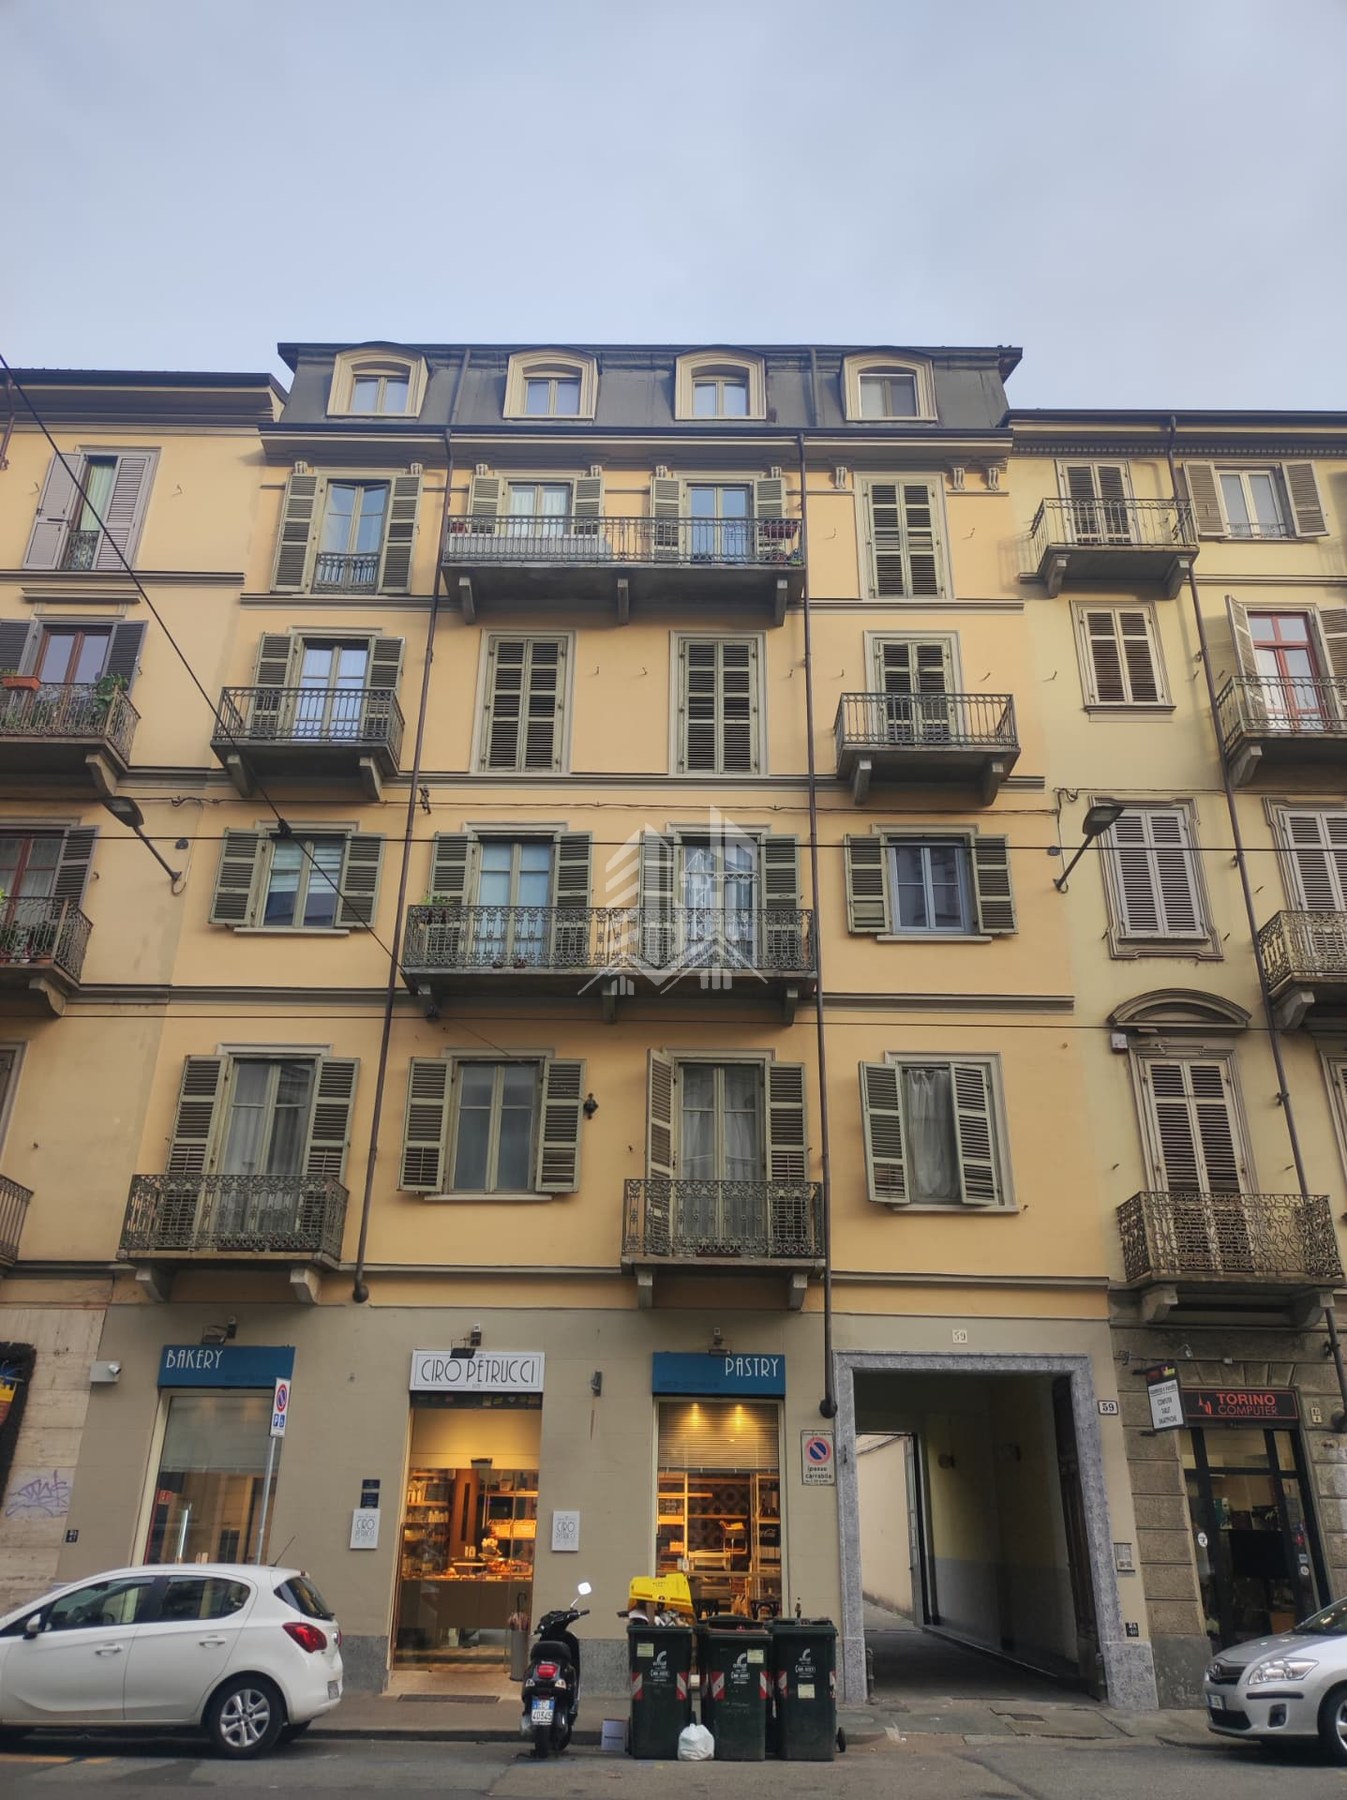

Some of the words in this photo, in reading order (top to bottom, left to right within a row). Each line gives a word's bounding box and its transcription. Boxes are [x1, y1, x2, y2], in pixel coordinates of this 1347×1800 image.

[165, 1349, 224, 1369] BAKERY
[421, 1359, 462, 1382] CIRO
[466, 1360, 535, 1383] PETRUCCI
[724, 1357, 779, 1377] PASTRY
[1216, 1393, 1276, 1406] TORINO
[1101, 1402, 1115, 1412] 59
[1217, 1404, 1279, 1416] COMPUTER
[356, 1518, 376, 1530] CIRO
[556, 1521, 576, 1533] CIRO
